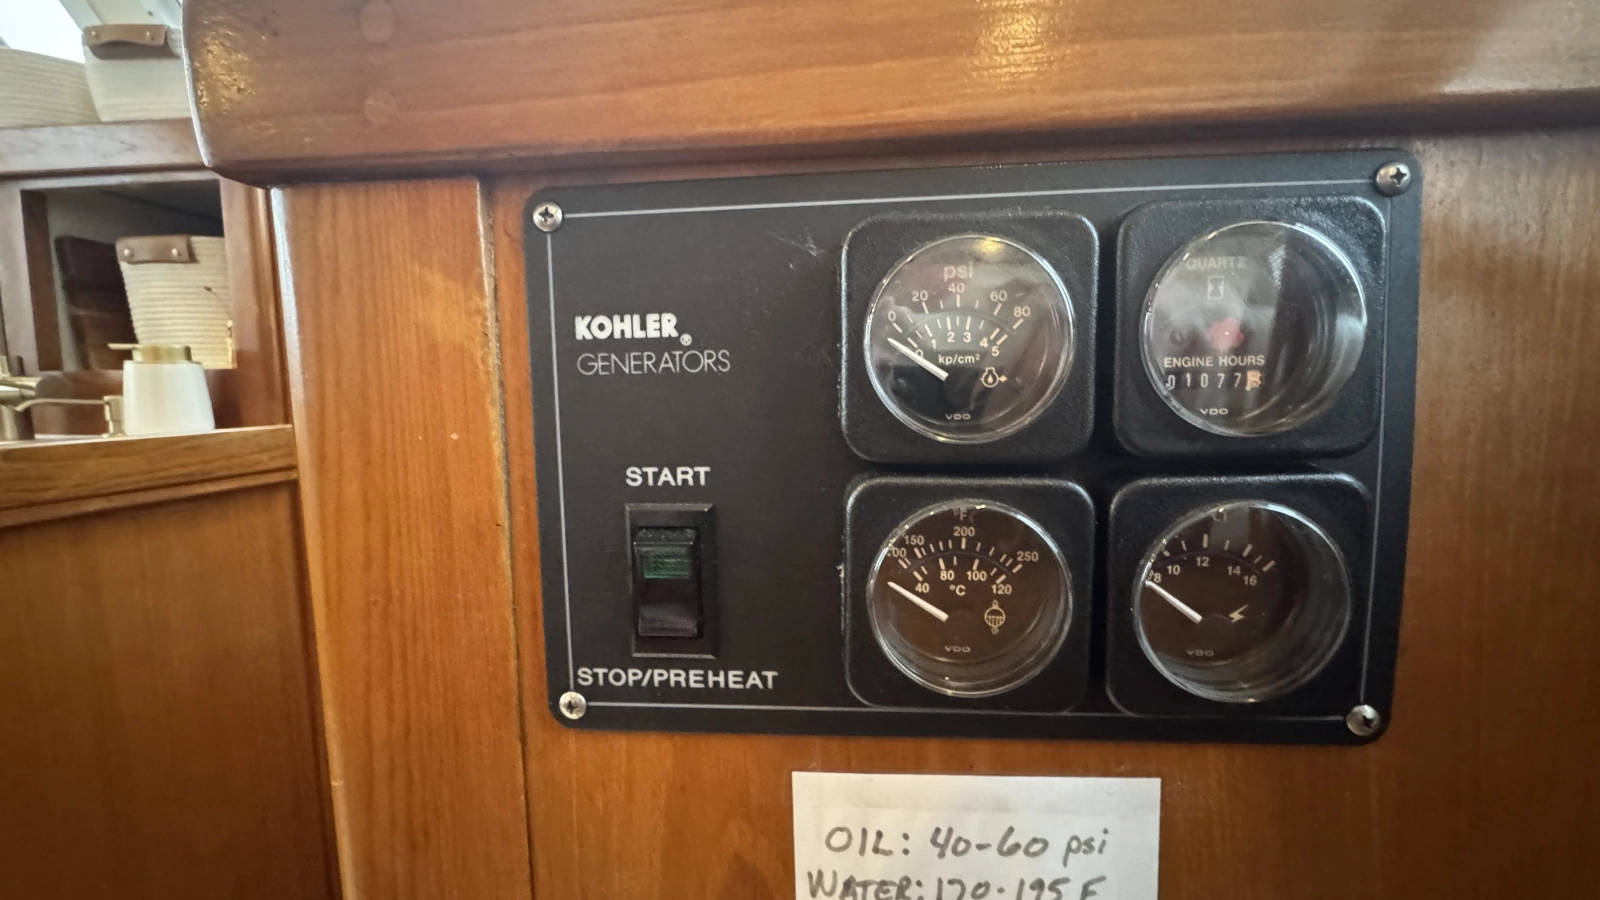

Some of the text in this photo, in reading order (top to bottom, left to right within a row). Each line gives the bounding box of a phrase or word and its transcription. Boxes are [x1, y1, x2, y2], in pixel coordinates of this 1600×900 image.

[1186, 256, 1247, 270] QUARTZ
[943, 261, 973, 282] psi
[948, 283, 965, 293] 40
[912, 291, 928, 302] 20
[990, 291, 1007, 301] 60
[888, 311, 896, 322] 0
[1014, 306, 1031, 317] 80
[947, 332, 955, 343] 2
[963, 332, 972, 343] 3
[979, 338, 989, 348] 4
[931, 339, 937, 350] 1
[991, 346, 1000, 357] 5
[577, 350, 731, 375] GENERATORS
[1163, 355, 1265, 368] ENGINE HOURS
[626, 466, 711, 487] START
[953, 526, 975, 537] 200
[904, 535, 925, 546] 150
[1017, 551, 1039, 562] 250
[1196, 556, 1210, 567] 12
[940, 570, 955, 581] 80
[1167, 565, 1180, 575] 10
[1227, 566, 1241, 576] 14
[967, 571, 987, 581] 100
[1243, 575, 1257, 586] 16
[915, 583, 930, 594] 40
[949, 585, 966, 596] °C
[991, 584, 1012, 595] 120
[944, 645, 971, 653] VDO
[577, 667, 779, 690] STOP/PREHEAT
[825, 826, 1109, 868] OIL: 40-60 psi
